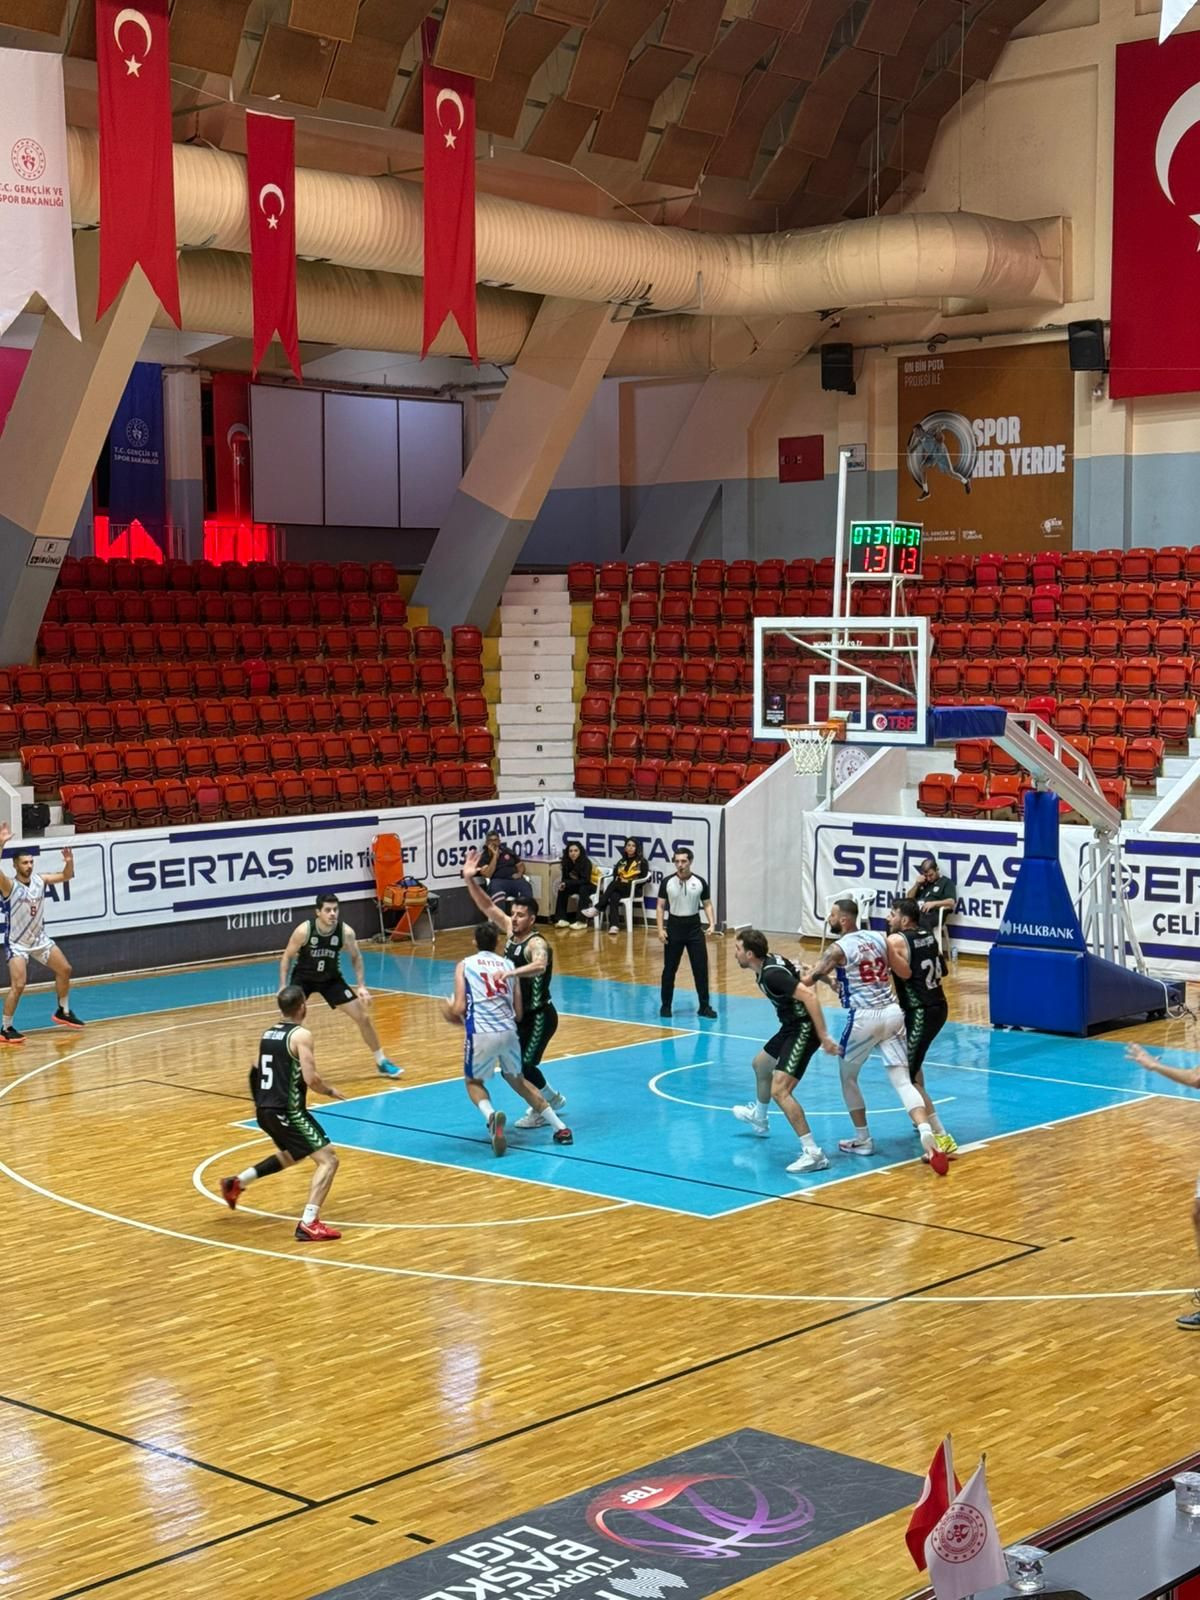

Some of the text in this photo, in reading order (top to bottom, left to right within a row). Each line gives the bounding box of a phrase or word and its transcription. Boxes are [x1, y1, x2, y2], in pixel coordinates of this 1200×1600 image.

[14, 185, 51, 195] GENÇLİK
[53, 187, 63, 196] VE
[21, 196, 64, 207] BAKANLIĞI
[972, 416, 1021, 447] SPOR
[972, 444, 1066, 478] HER YERDE
[888, 716, 915, 729] TBF
[128, 847, 418, 893] SERTAŞ DEMİR TİET
[1012, 924, 1074, 940] HALKBANK
[317, 960, 325, 972] 8
[261, 1055, 273, 1090] 5
[620, 1486, 664, 1505] TBF
[447, 1525, 557, 1571] LİGİ
[499, 1556, 630, 1600] TÜRKİY
